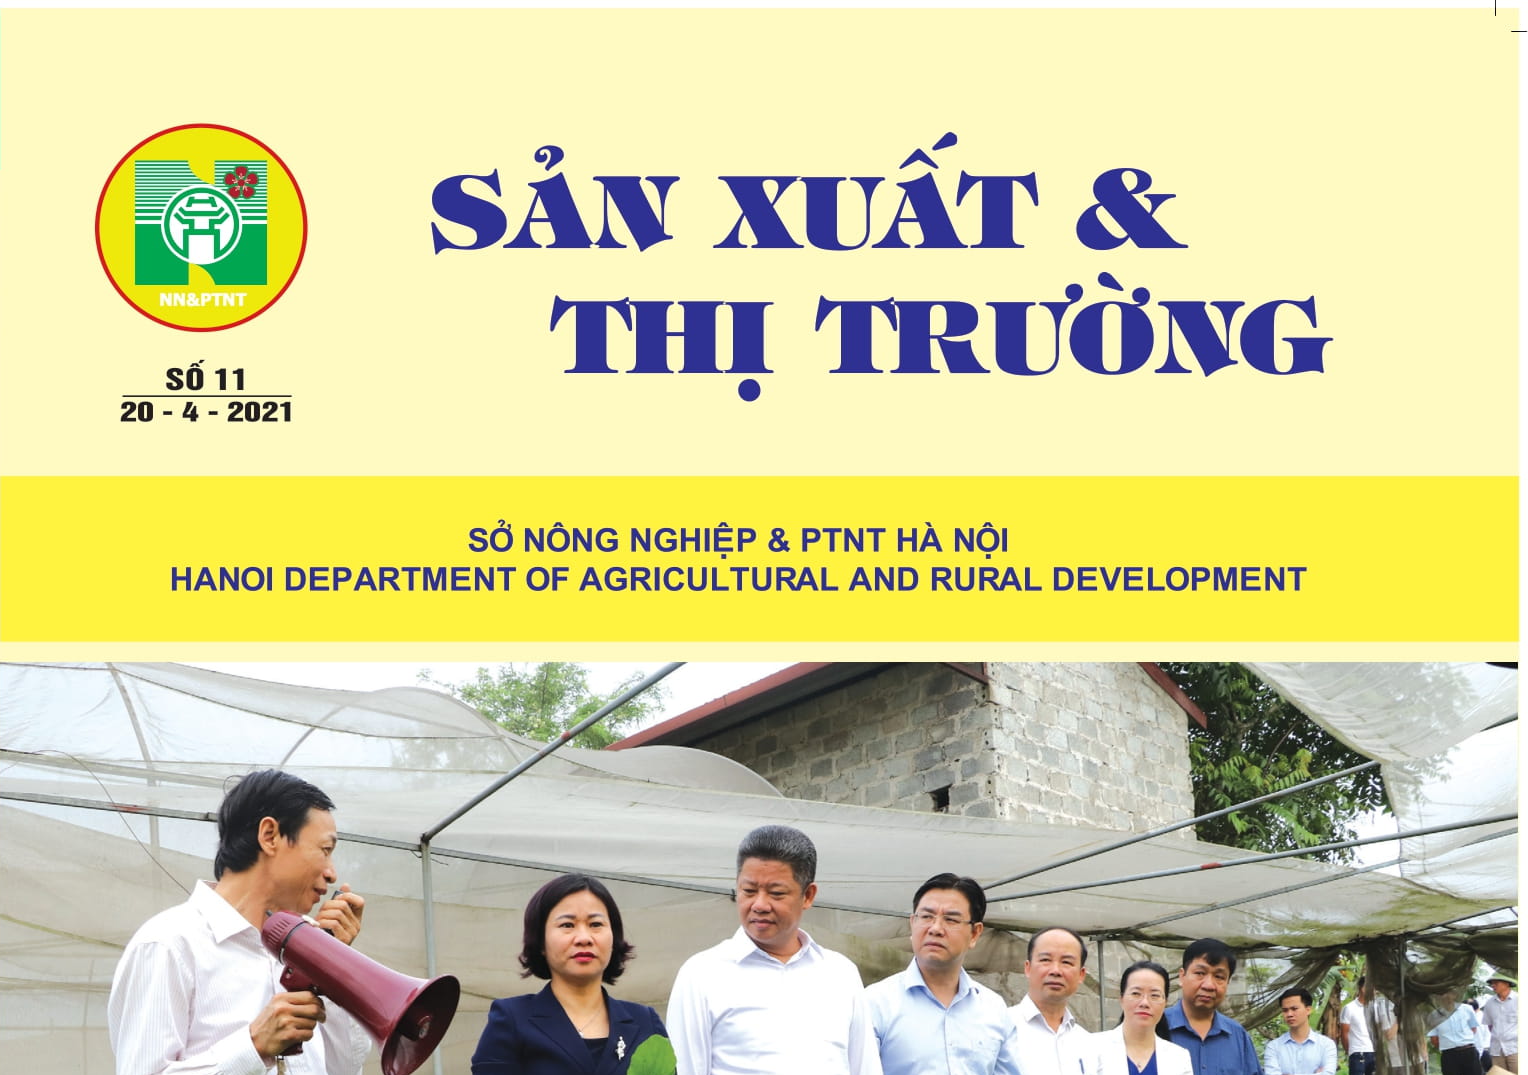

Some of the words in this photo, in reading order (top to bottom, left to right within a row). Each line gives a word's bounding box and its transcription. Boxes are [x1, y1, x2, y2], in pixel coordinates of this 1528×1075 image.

[430, 144, 681, 255] SẢN
[712, 131, 1039, 251] XUẤT
[1075, 167, 1189, 251] &
[158, 291, 248, 308] NN&PTNT
[549, 295, 775, 402] THỊ
[814, 271, 1334, 378] TRƯỜNG
[165, 359, 205, 391] SỐ
[214, 368, 244, 391] 11
[120, 401, 154, 423] 20
[182, 401, 199, 422] 4
[227, 401, 291, 423] 2021
[468, 519, 514, 553] SỞ
[524, 521, 619, 553] NÔNG
[630, 521, 757, 560] NGHIỆP
[767, 527, 791, 553] &
[801, 527, 887, 553] PTNT
[897, 521, 943, 553] HÀ
[954, 521, 1008, 560] NỘI
[171, 566, 273, 592] HANOI
[285, 566, 517, 592] DEPARTMENT
[525, 566, 570, 592] OF
[579, 566, 839, 592] AGRICULTURAL
[848, 566, 919, 592] AND
[931, 566, 1043, 592] RURAL
[1053, 566, 1308, 592] DEVELOPMENT
